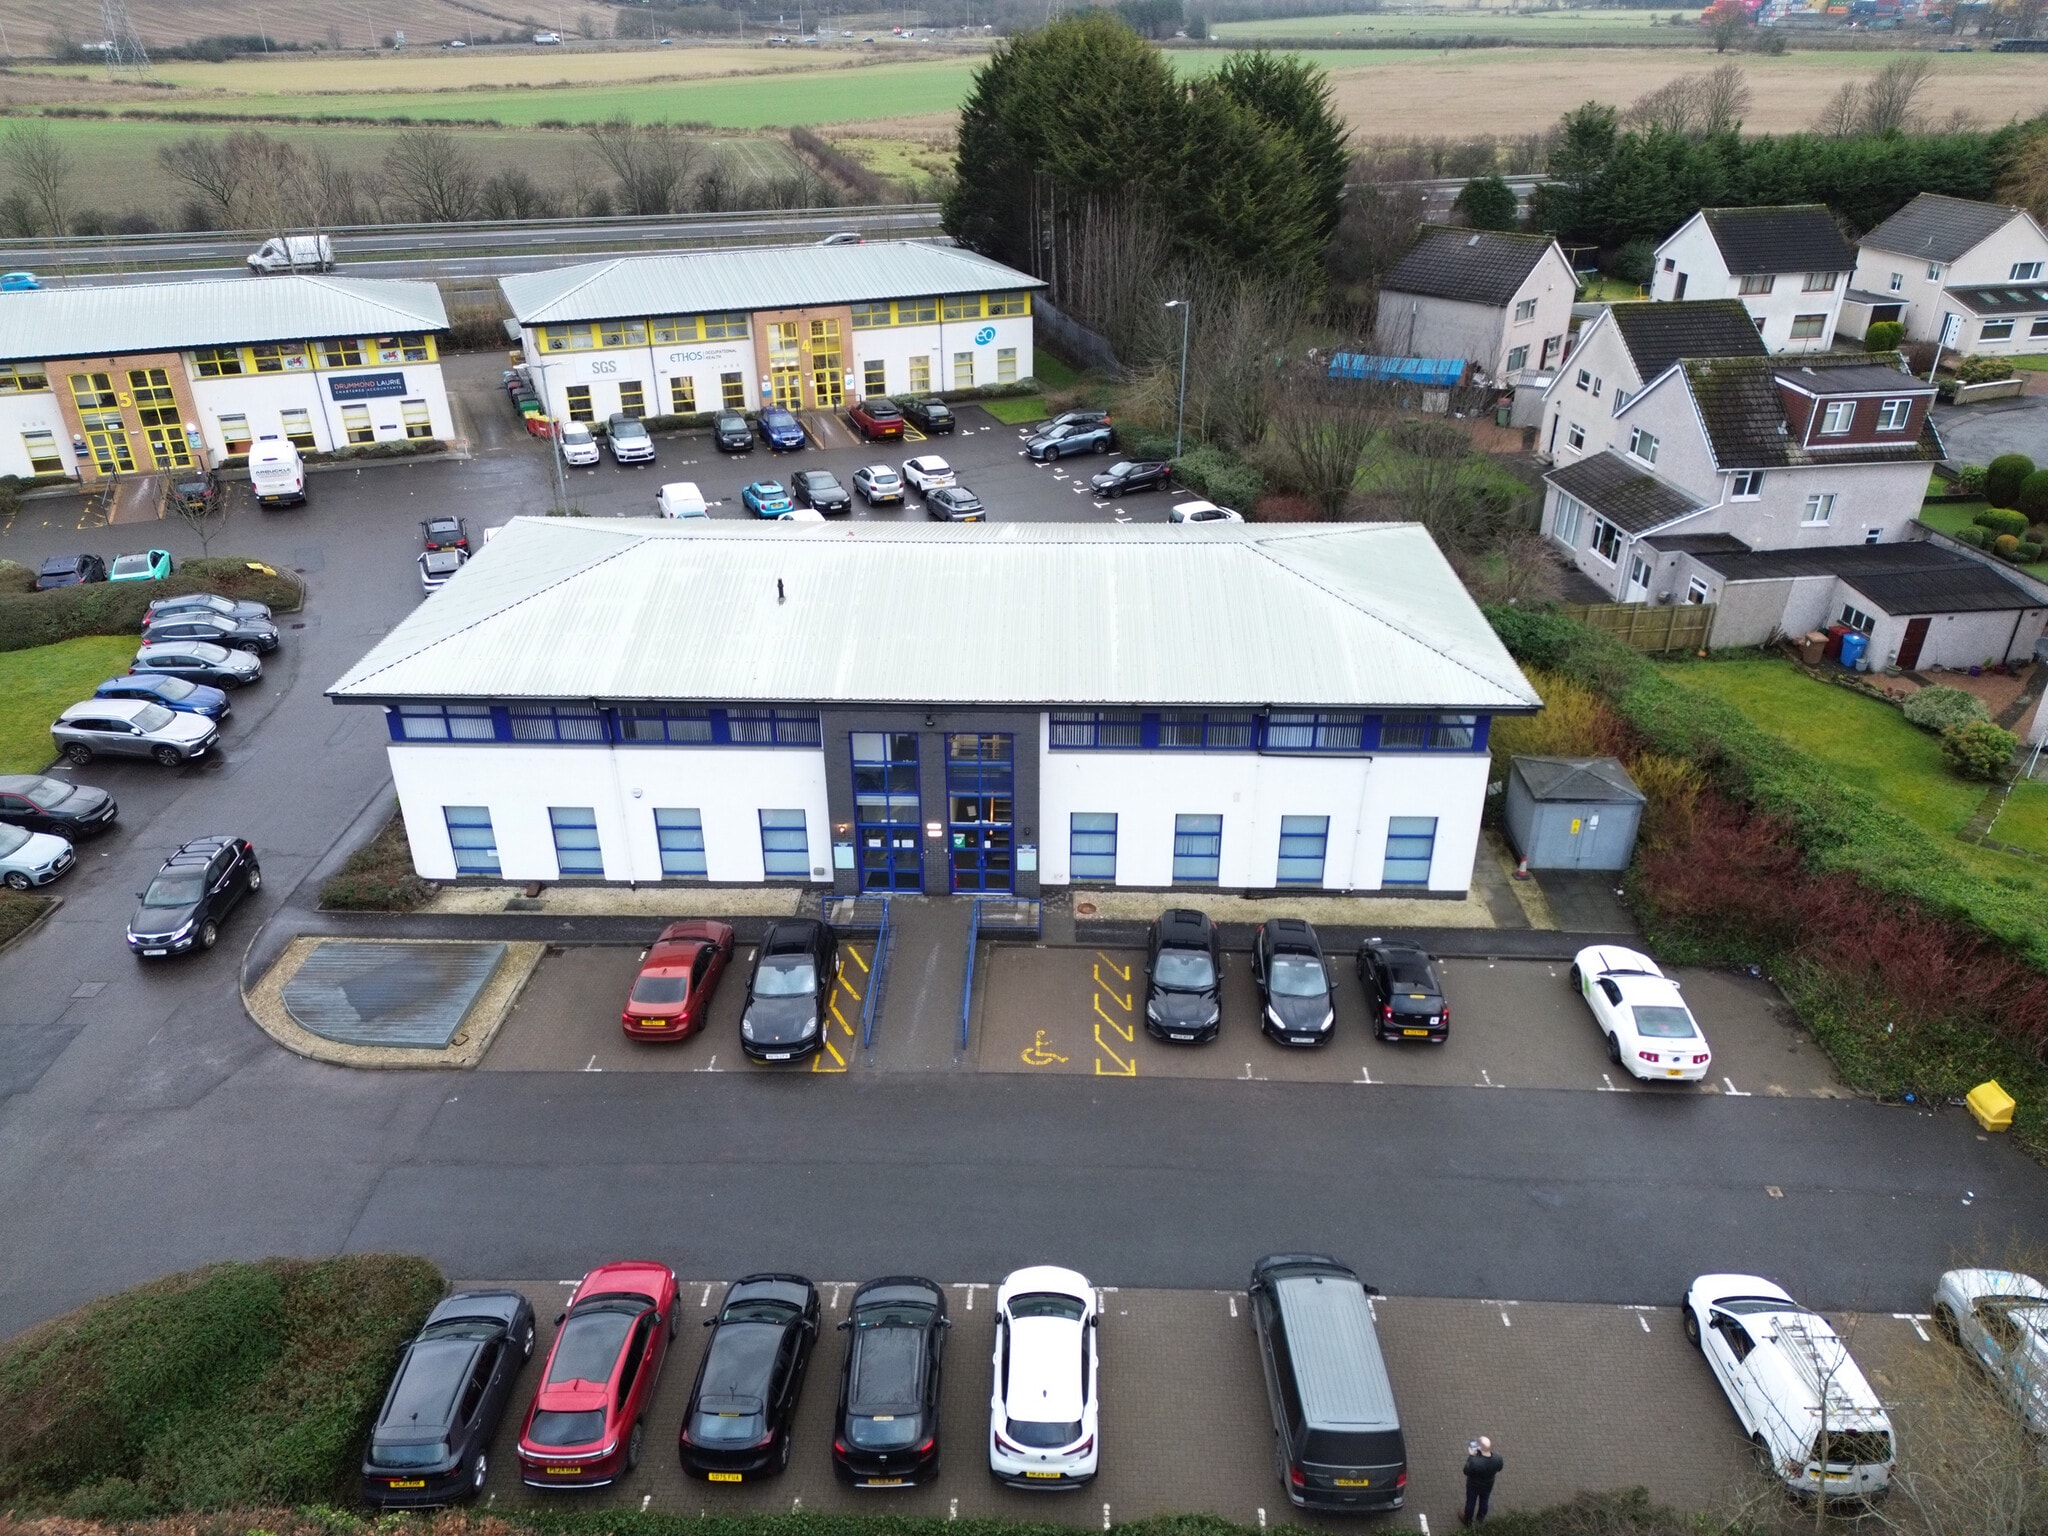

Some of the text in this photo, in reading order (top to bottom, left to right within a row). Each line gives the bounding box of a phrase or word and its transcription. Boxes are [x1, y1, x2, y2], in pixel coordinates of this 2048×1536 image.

[802, 339, 811, 353] 4
[669, 351, 703, 363] ETHOS
[591, 360, 617, 374] SGS
[333, 378, 401, 390] DRUMMOND LAURIE
[118, 391, 132, 408] 5
